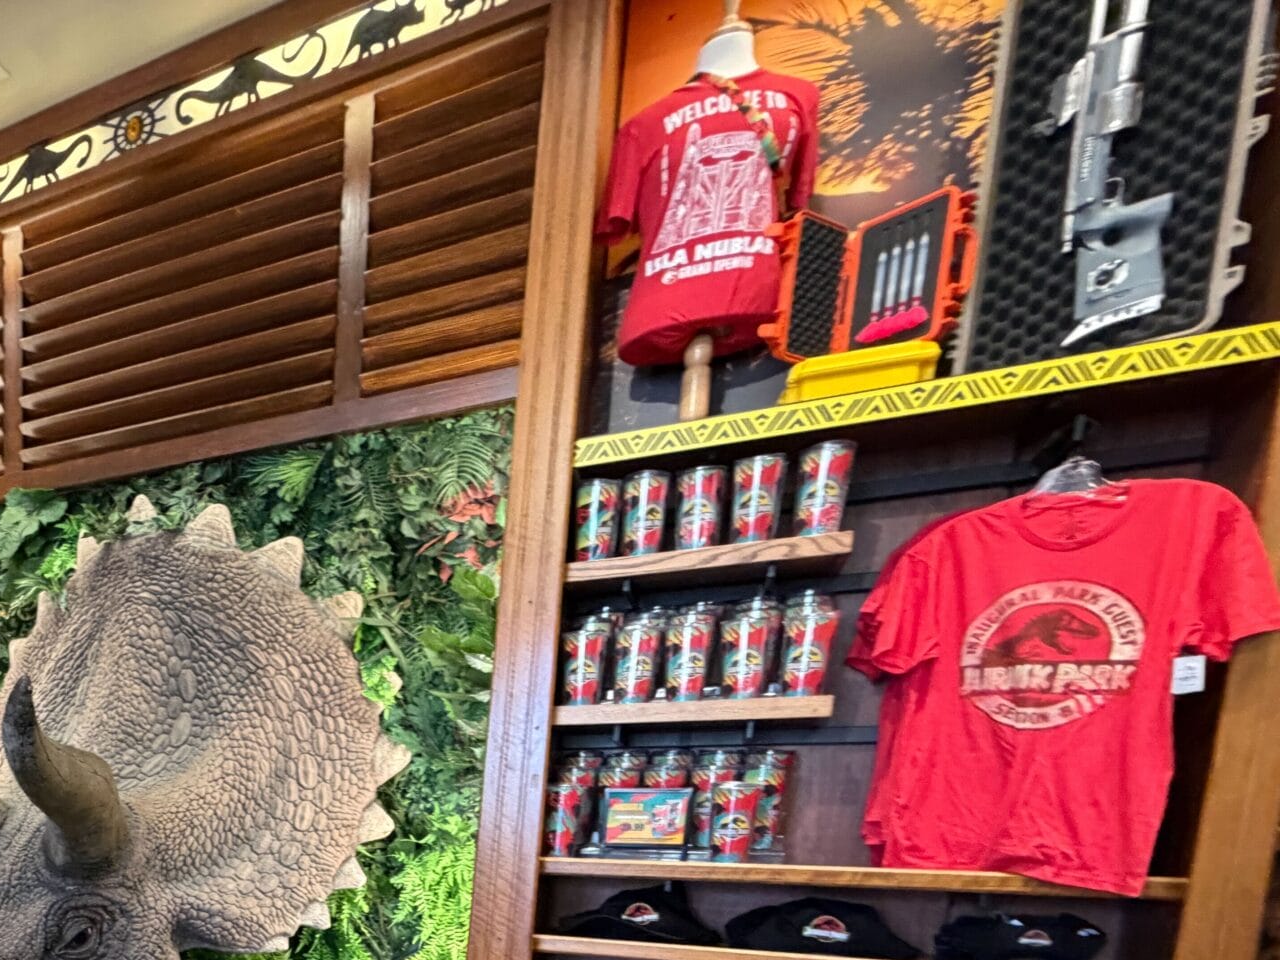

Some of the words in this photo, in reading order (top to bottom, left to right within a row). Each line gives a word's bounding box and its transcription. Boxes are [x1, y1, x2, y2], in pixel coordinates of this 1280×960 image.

[765, 91, 787, 109] TO
[966, 589, 1041, 655] INAUGURAL
[1052, 586, 1102, 606] PARK
[1102, 602, 1138, 646] GUEST
